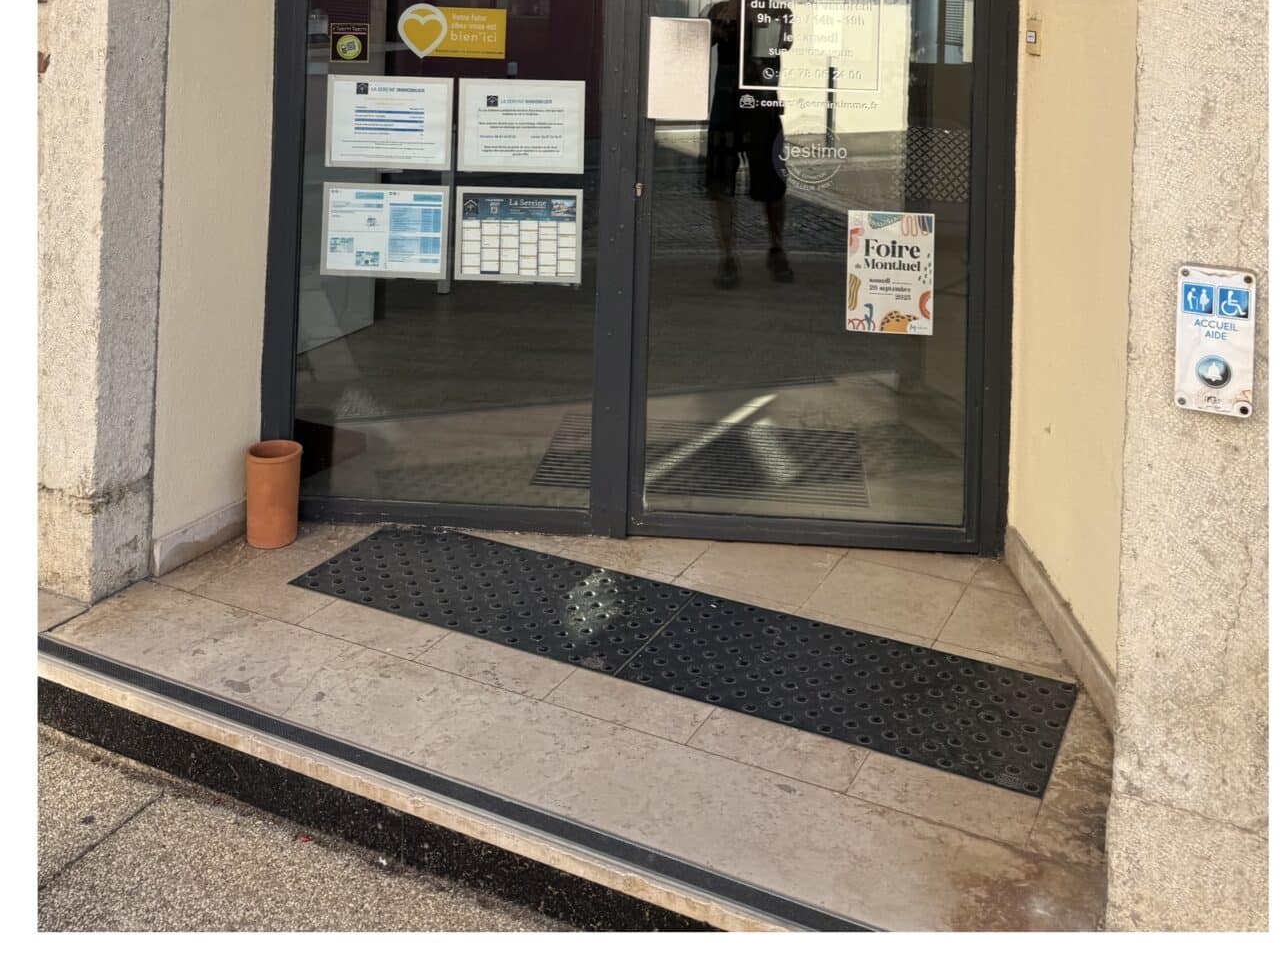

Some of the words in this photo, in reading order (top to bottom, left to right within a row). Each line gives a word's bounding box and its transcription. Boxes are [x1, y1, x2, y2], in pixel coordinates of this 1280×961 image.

[750, 0, 765, 8] du
[757, 14, 771, 24] 9h
[778, 143, 848, 161] jestimo
[864, 238, 921, 259] Foire
[863, 258, 921, 272] Montluel
[1194, 319, 1239, 332] ACCUEIL
[1204, 330, 1229, 340] AIDE
